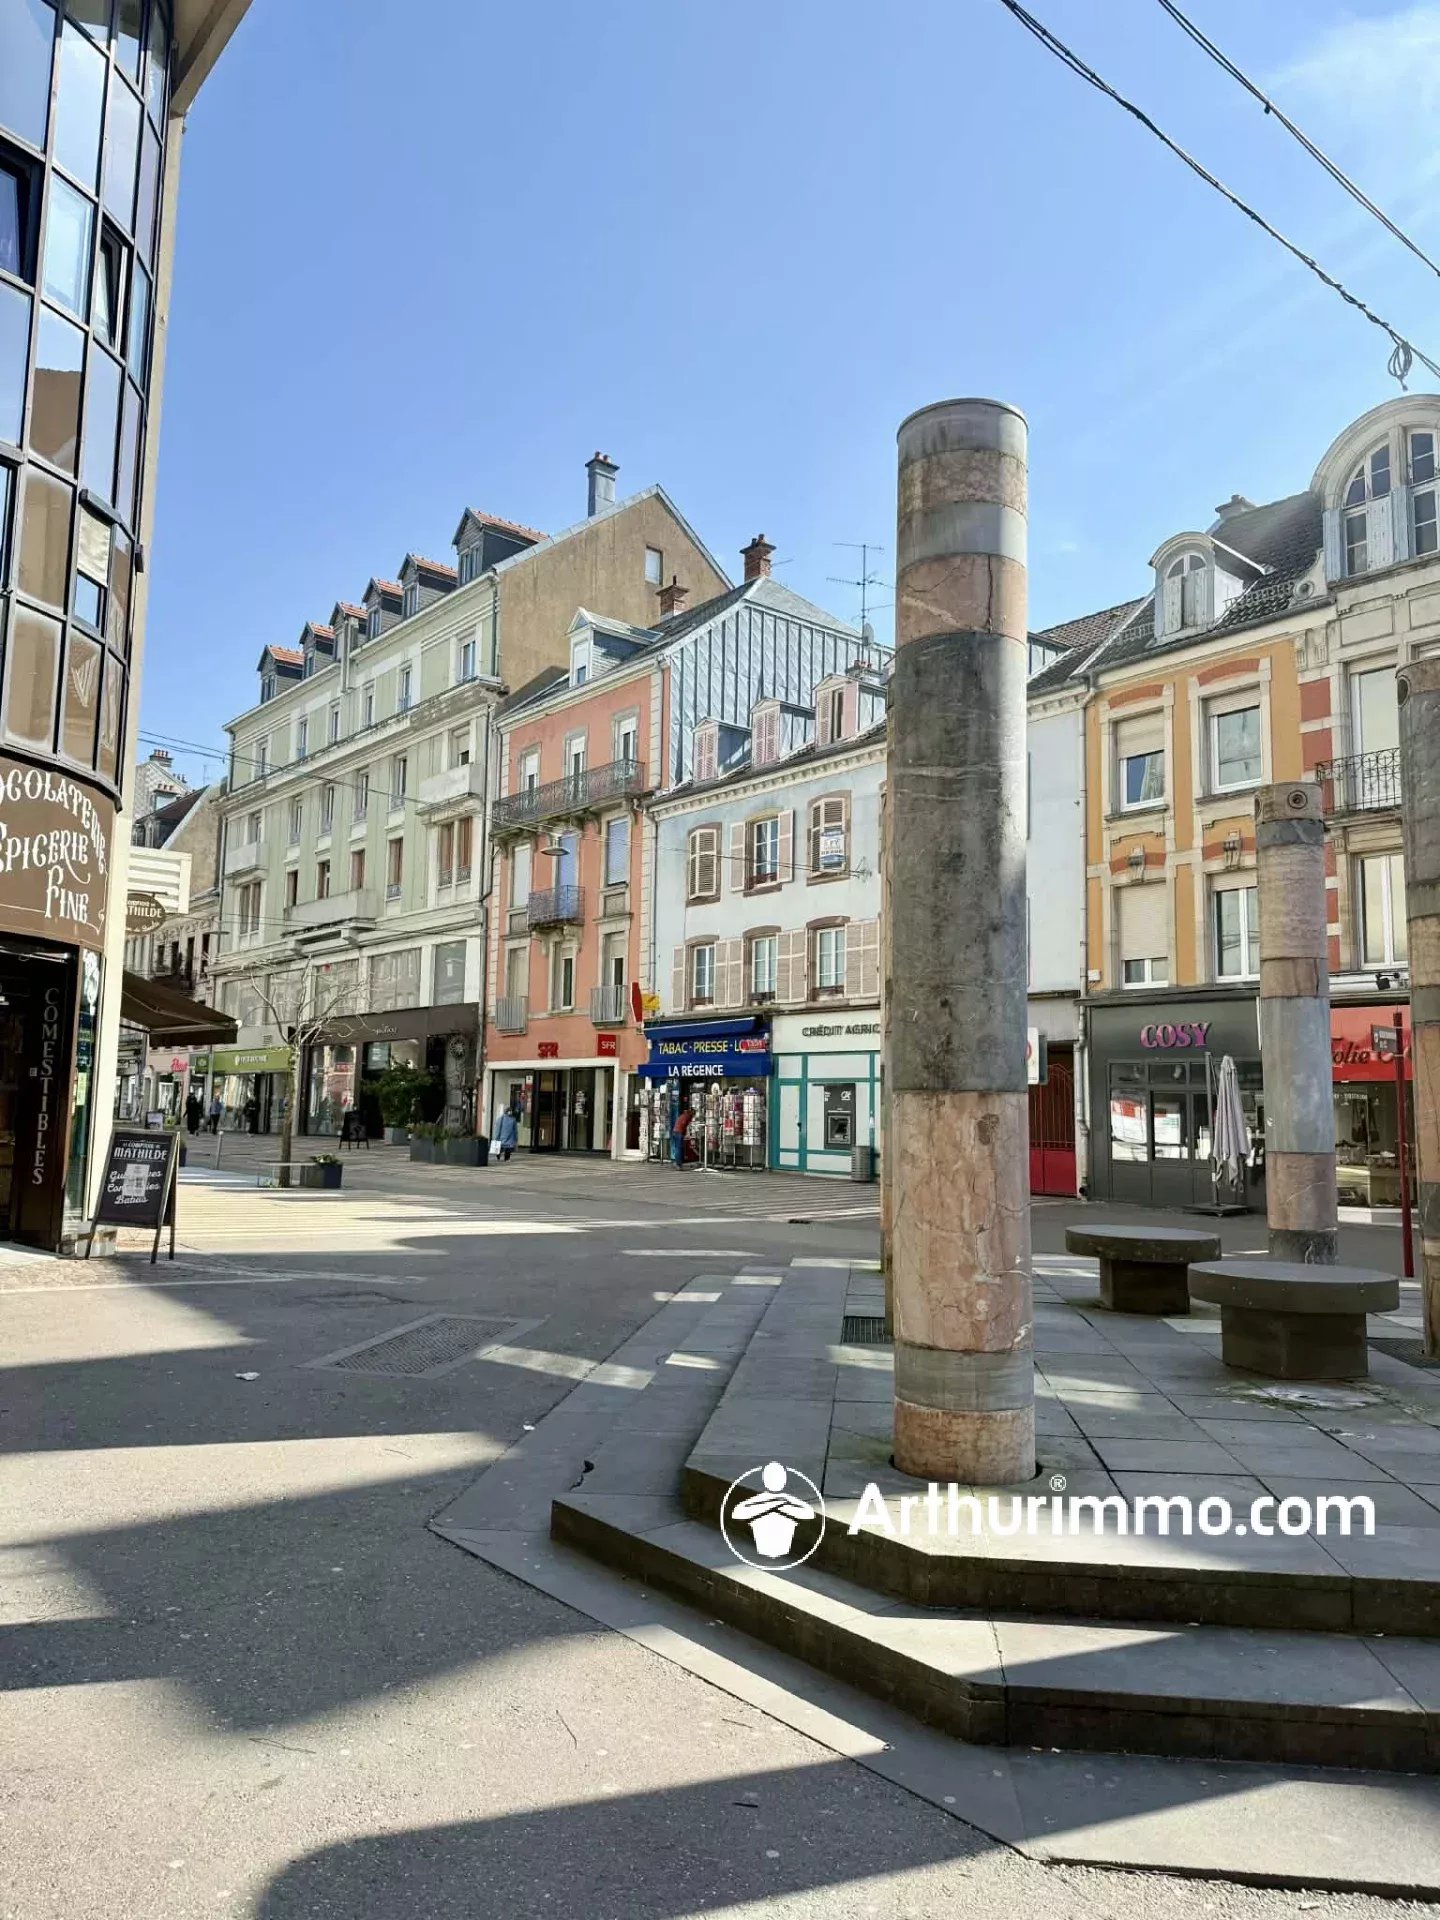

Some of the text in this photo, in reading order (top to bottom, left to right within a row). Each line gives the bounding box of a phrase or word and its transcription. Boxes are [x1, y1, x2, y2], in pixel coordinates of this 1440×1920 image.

[0, 768, 107, 875] COLATERIE
[802, 1024, 843, 1037] CRÉDIT
[1140, 1022, 1211, 1048] COSY
[538, 1042, 559, 1059] SFR
[601, 1040, 616, 1050] SFR
[658, 1041, 688, 1055] TABAC
[693, 1040, 728, 1053] PRESSE
[668, 1063, 724, 1077] LA RÉGENCE
[32, 988, 59, 1185] COMESTIBLES
[114, 1147, 168, 1160] MATHILDE
